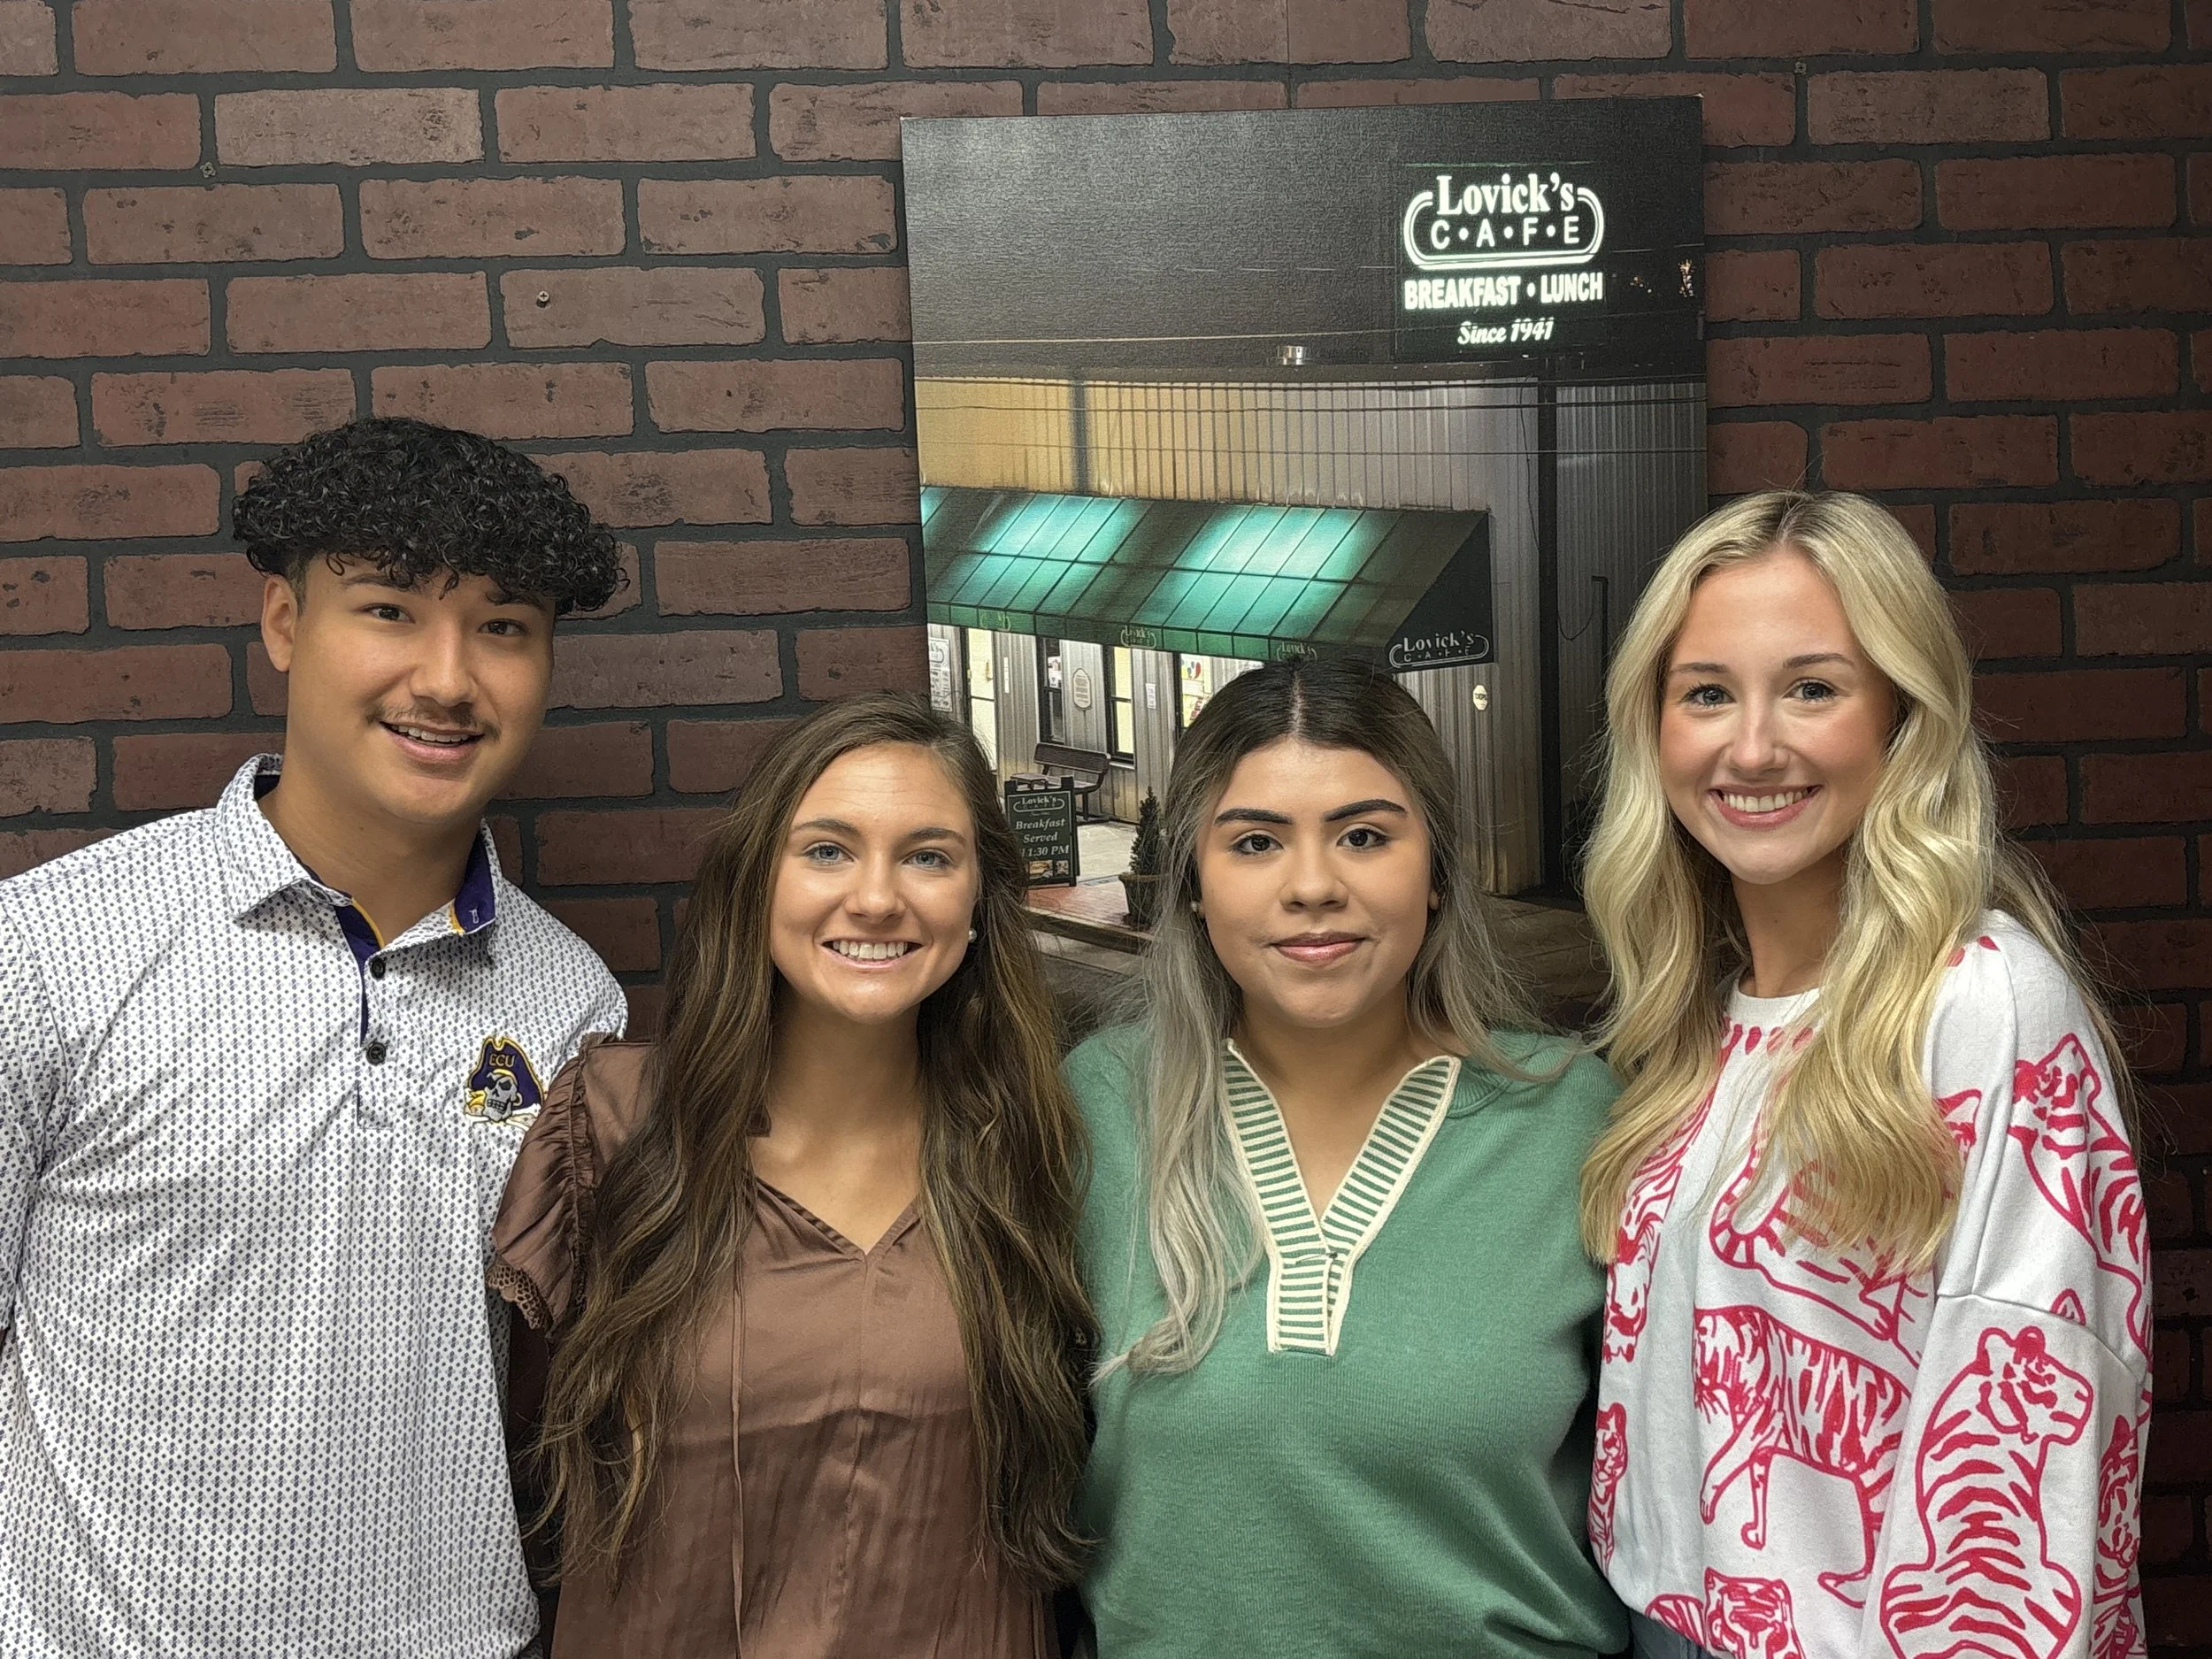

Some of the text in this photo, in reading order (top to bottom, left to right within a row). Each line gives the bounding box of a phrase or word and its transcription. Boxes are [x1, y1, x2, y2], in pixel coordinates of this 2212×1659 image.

[1436, 172, 1576, 215] Lovick's
[1404, 273, 1603, 310] BREAKFAST LUNCH
[1457, 317, 1555, 344] Since 1941
[1403, 629, 1474, 652] Lovick's
[1021, 795, 1057, 805] Lovick's
[1015, 818, 1066, 831] Breakfast
[1023, 832, 1058, 843] Served
[1051, 844, 1070, 856] PM
[489, 1054, 516, 1068] ECU
